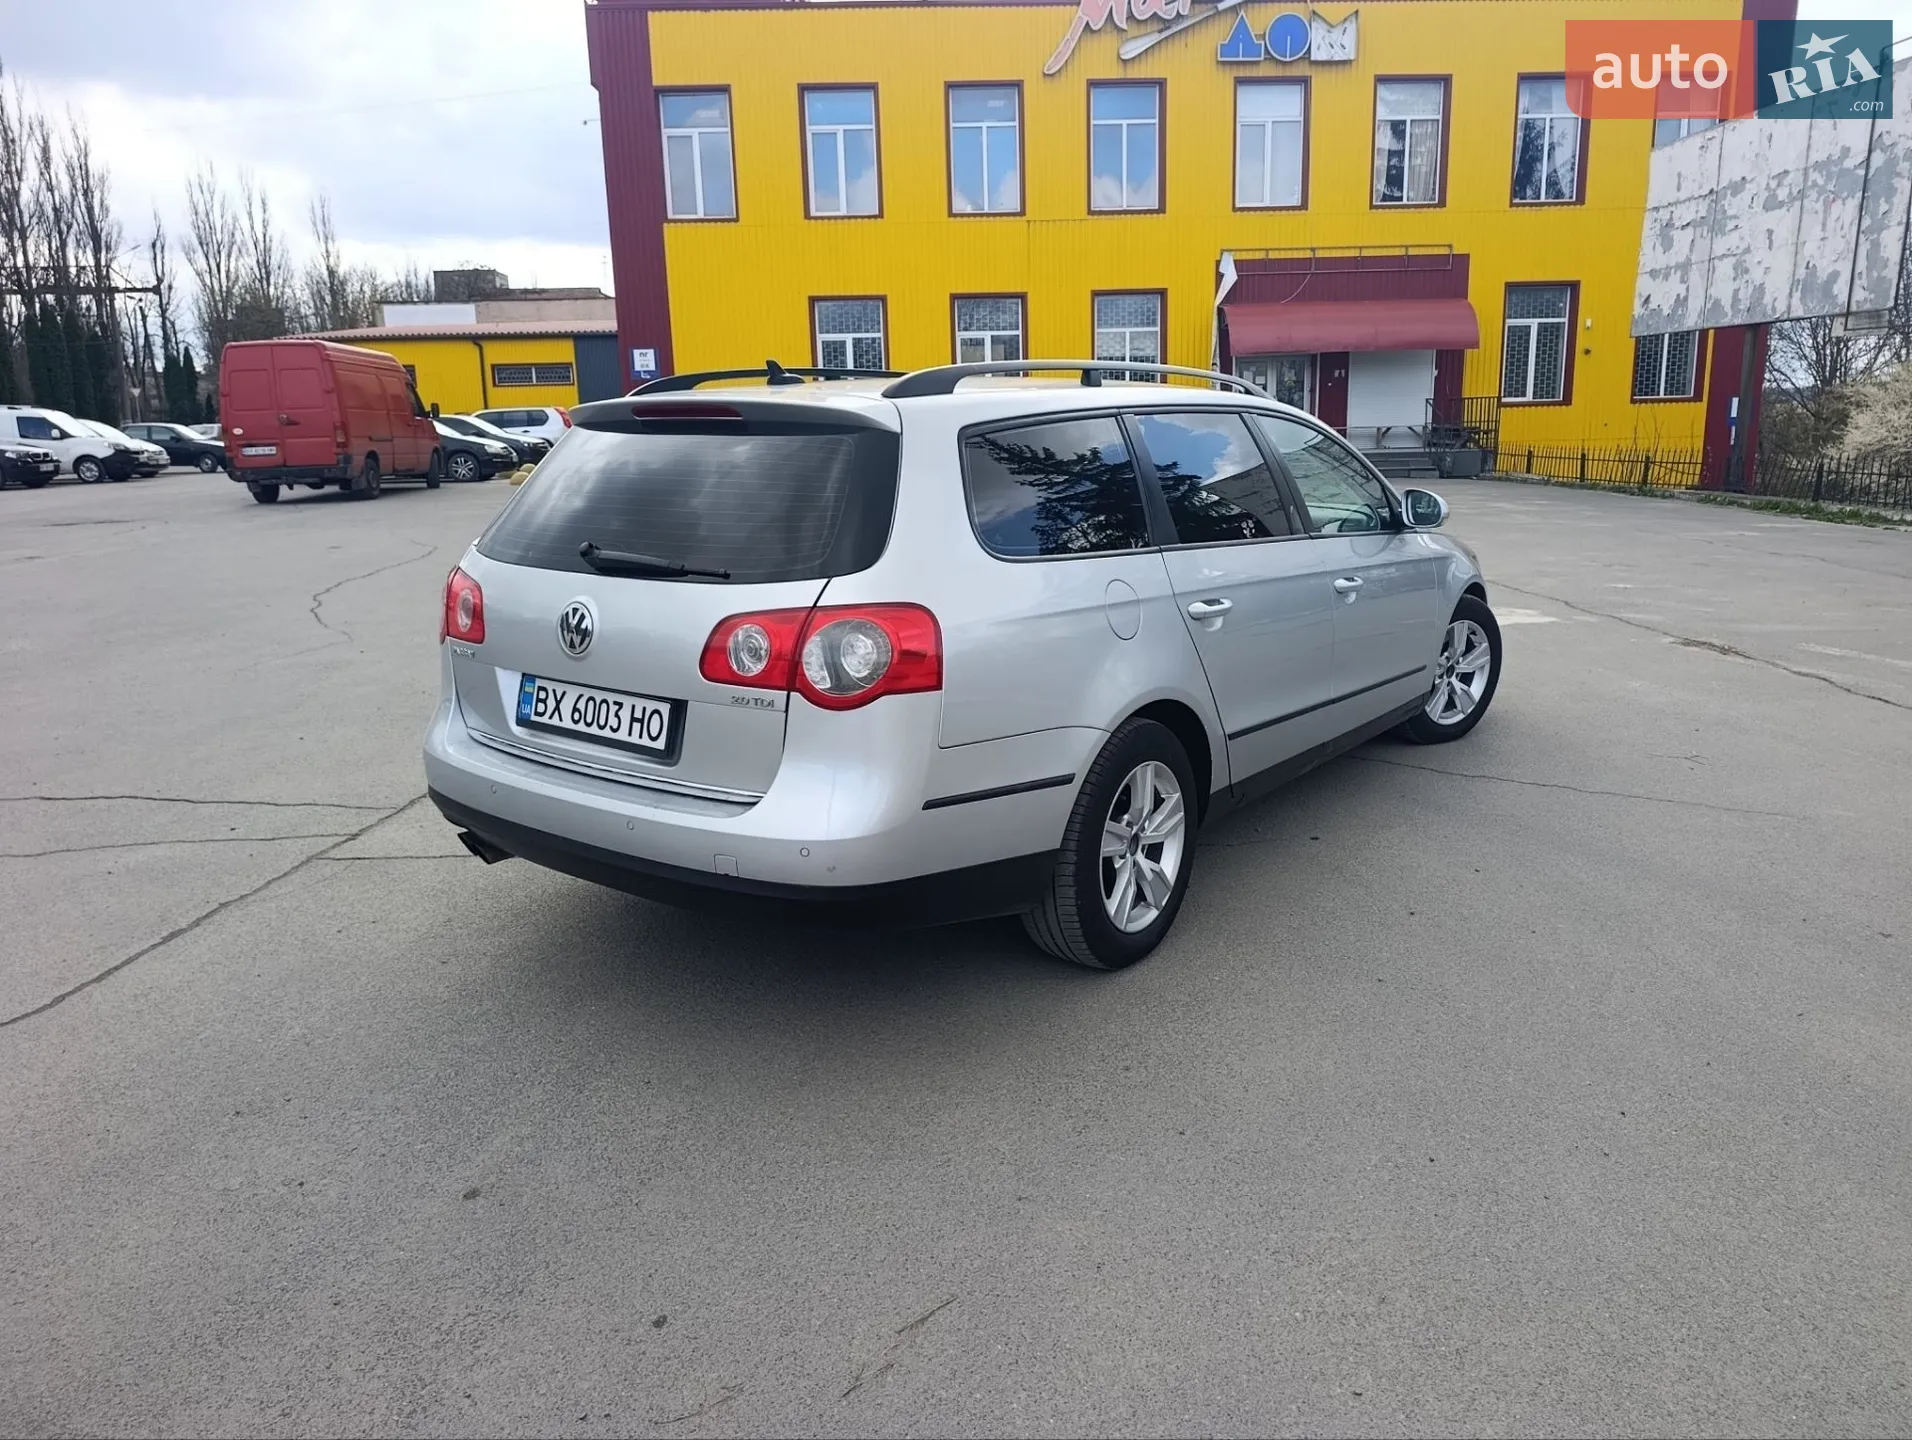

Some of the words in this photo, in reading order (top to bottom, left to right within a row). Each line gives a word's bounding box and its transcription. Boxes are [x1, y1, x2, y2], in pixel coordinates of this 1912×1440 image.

[1217, 9, 1358, 62] ДОМ
[521, 703, 532, 715] UA
[533, 685, 567, 722] BX
[570, 693, 624, 734] 6003
[628, 704, 664, 742] HO
[751, 696, 775, 708] TDI
